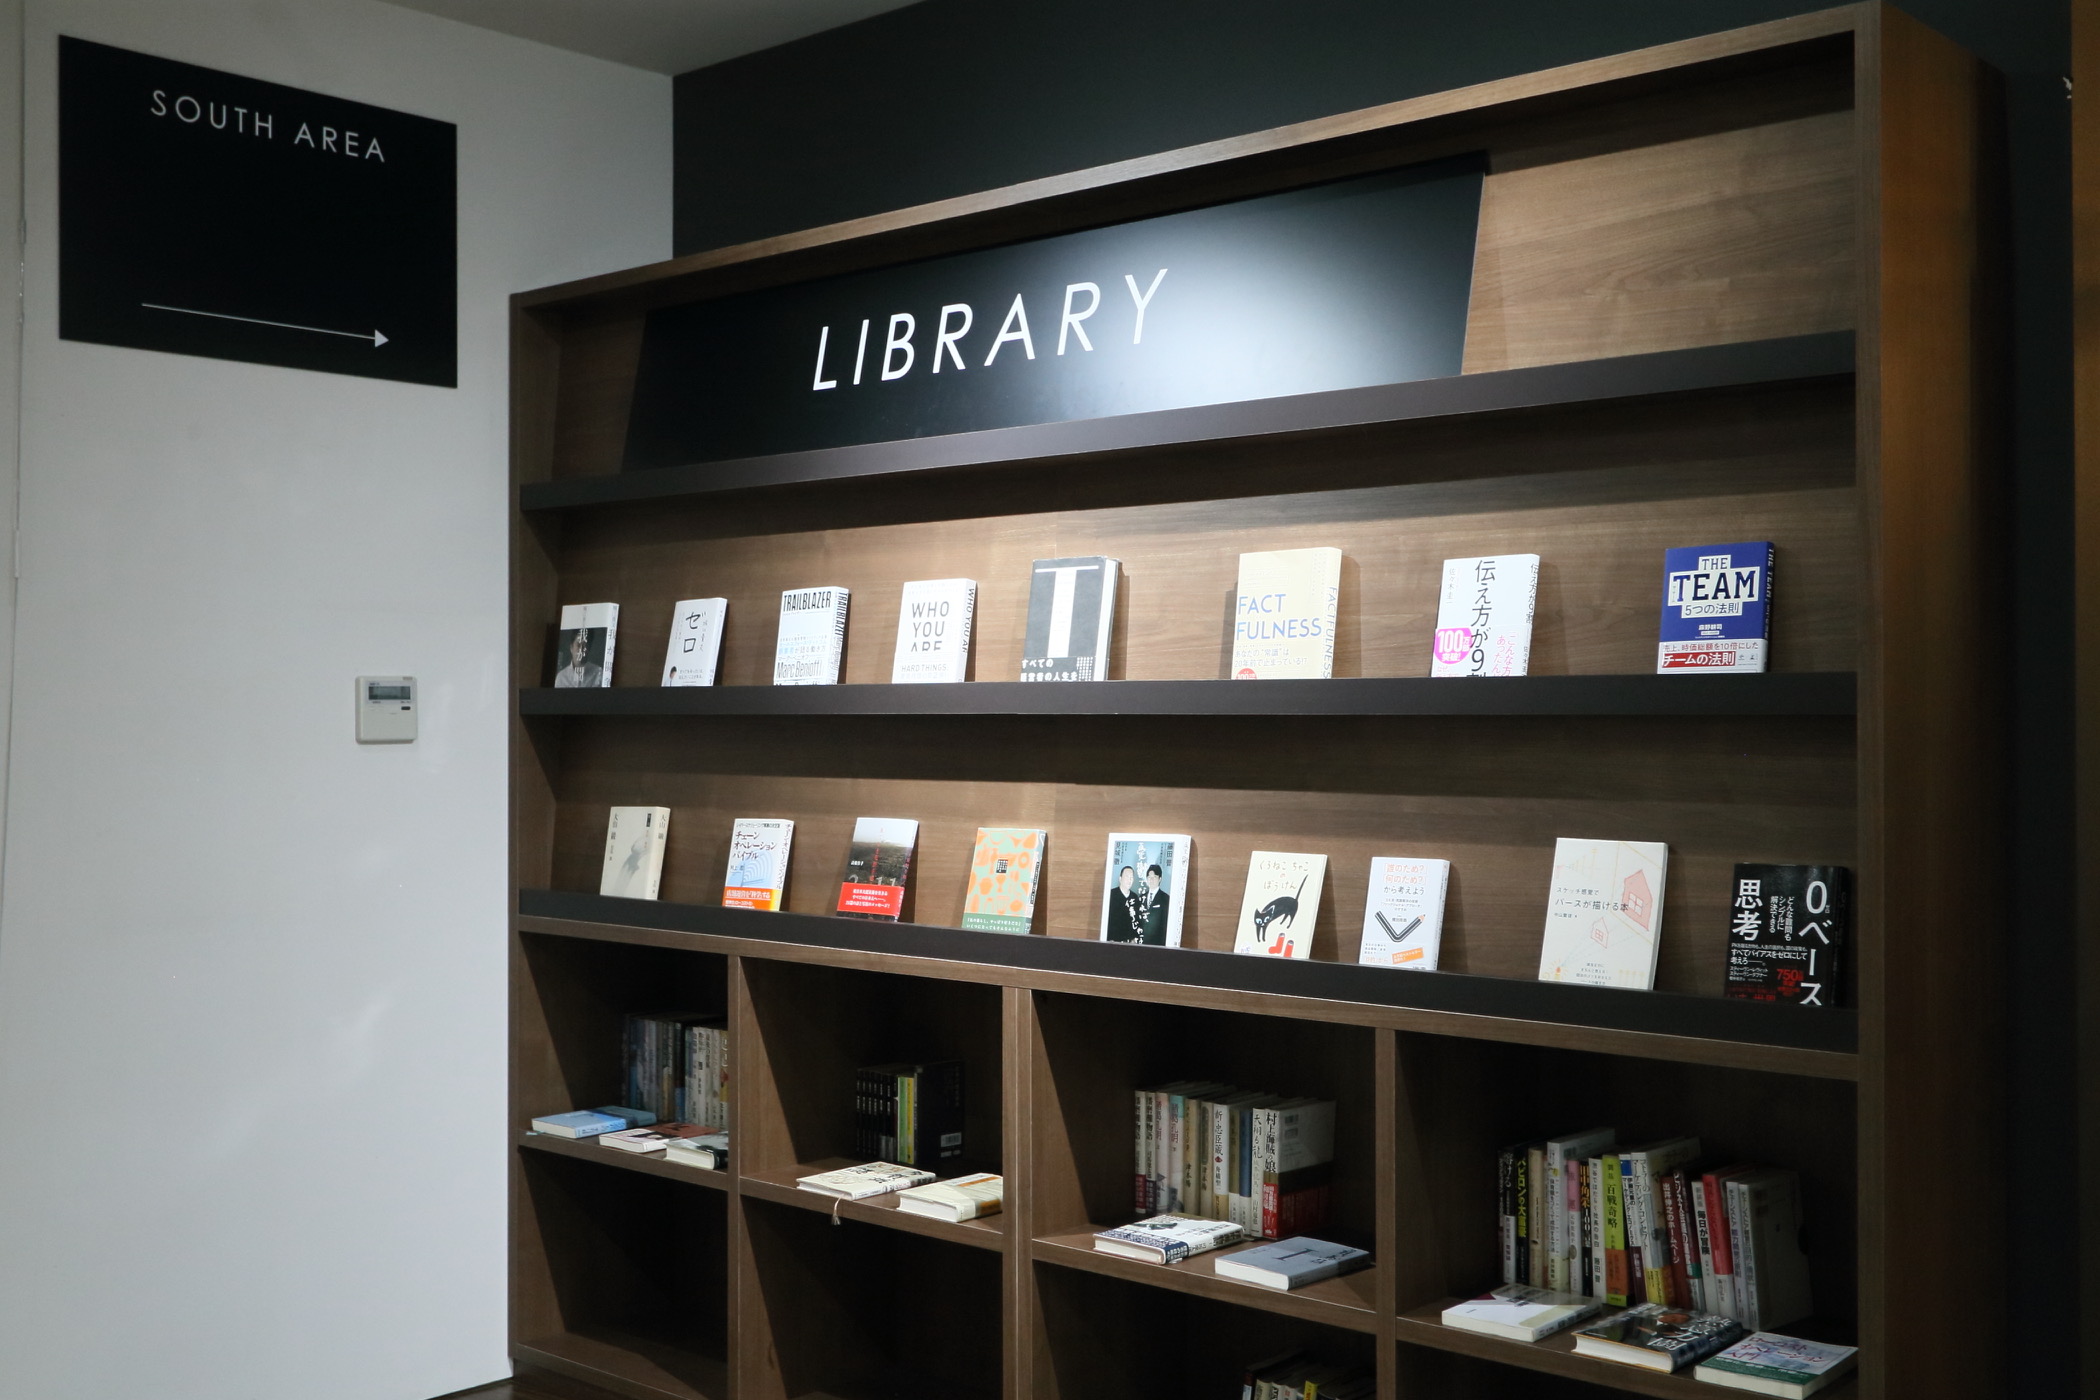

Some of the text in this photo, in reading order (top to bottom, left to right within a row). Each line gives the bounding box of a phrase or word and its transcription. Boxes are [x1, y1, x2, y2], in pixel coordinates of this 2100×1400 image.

[150, 88, 386, 163] SOUTH AREA
[812, 267, 1169, 392] LIBRARY
[1701, 557, 1728, 571] THE
[1673, 570, 1756, 602] TEAM
[783, 591, 832, 612] TRAILBLAZER
[911, 601, 950, 619] WHO
[1238, 594, 1286, 615] FACT
[1685, 602, 1739, 616] 5つの法則
[913, 621, 945, 638] YOU
[1236, 618, 1322, 640] FULNESS
[1022, 658, 1054, 669] すべての
[1663, 652, 1735, 667] チームの法則
[735, 830, 760, 840] チェーン
[734, 841, 777, 851] オペレーション
[733, 851, 759, 861] バイブル
[1383, 885, 1425, 896] から考えよう
[1556, 887, 1600, 896] スケッチ感覚で
[1555, 898, 1629, 912] パースが描ける本
[1732, 879, 1763, 941] 思考
[1799, 880, 1833, 1006] 0ベース
[1265, 1112, 1278, 1173] 村上海賊の娘
